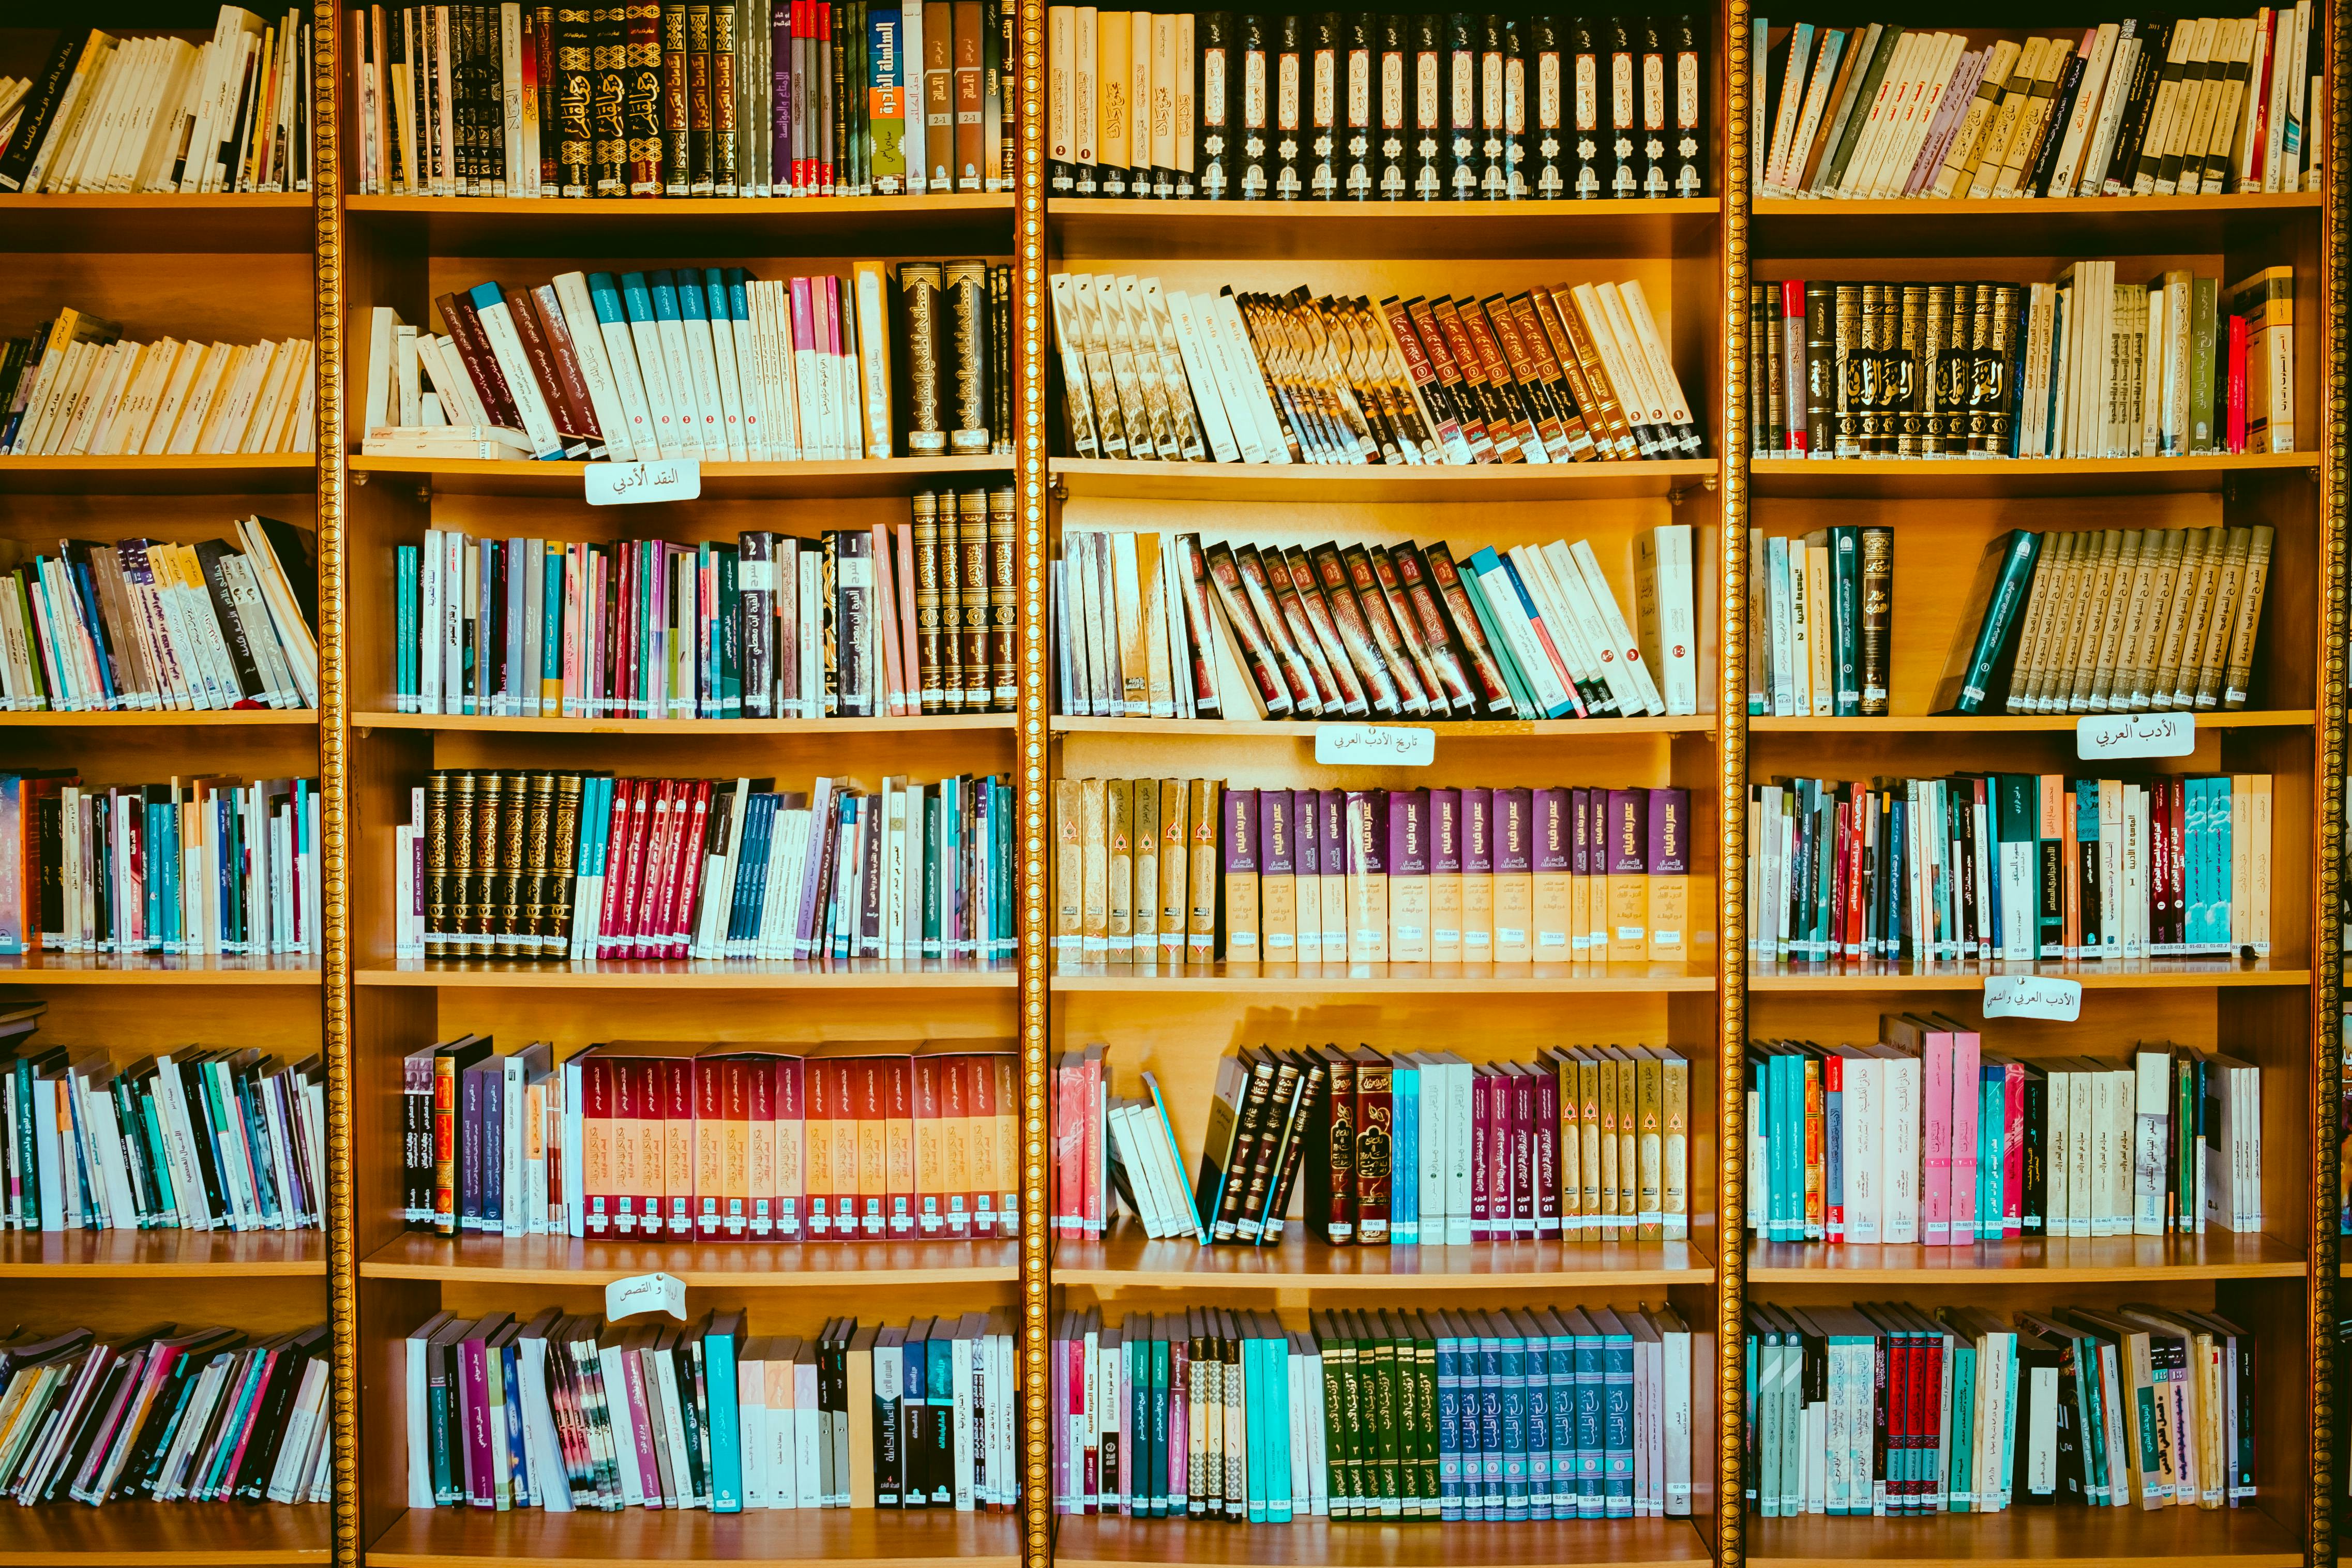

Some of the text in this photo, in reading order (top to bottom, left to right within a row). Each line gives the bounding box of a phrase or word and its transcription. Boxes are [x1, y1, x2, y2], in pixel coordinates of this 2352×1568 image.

[875, 23, 898, 113] السلسلة النادرة
[2075, 91, 2091, 133] سلطان النص
[613, 465, 678, 494] النقد الأدبي
[748, 540, 756, 555] 2
[852, 539, 857, 552] 1
[134, 572, 141, 581] 12
[1335, 730, 1417, 752] تاريخ الأدب العربي
[2097, 719, 2176, 747] الأدب العربي
[2046, 786, 2056, 803] محمد
[1235, 802, 1245, 818] عمر
[1664, 802, 1676, 821] عمر
[2047, 847, 2056, 910] الأدب الجزائري المعاصر
[2015, 991, 2041, 1005] العربي
[2046, 992, 2073, 1005] الأدب
[620, 1282, 651, 1301] القصص
[884, 1433, 894, 1461] الكاملة
